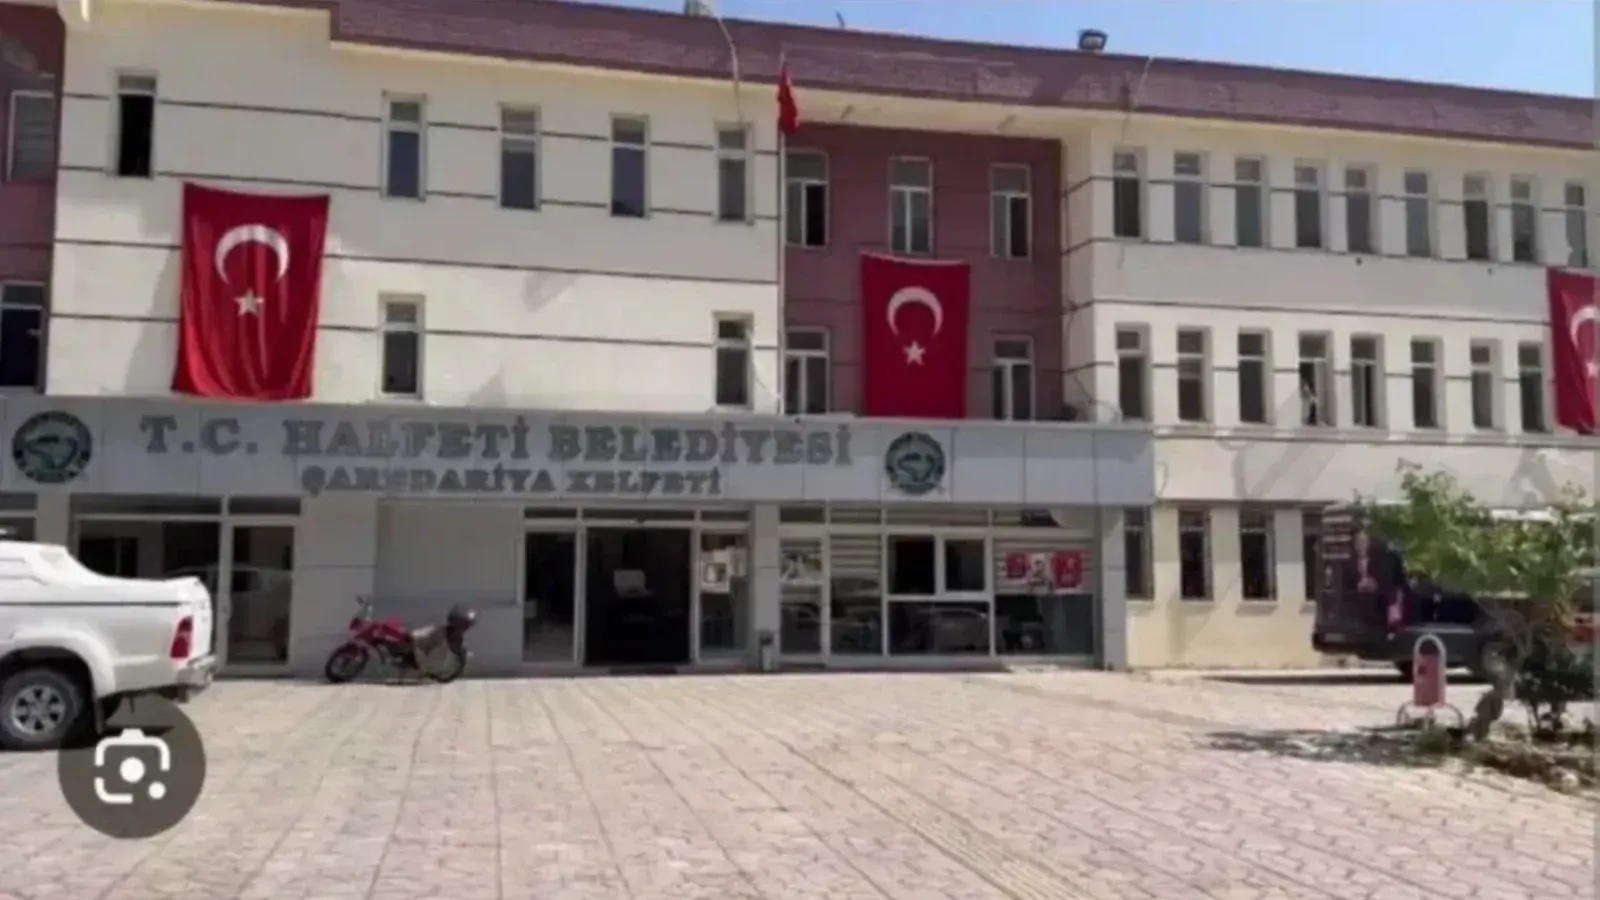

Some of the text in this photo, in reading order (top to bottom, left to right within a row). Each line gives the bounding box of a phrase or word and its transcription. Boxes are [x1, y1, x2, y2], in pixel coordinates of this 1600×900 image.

[140, 414, 259, 455] T.C.
[282, 415, 529, 458] HALFETİ
[547, 420, 853, 464] BELEDİYESİ
